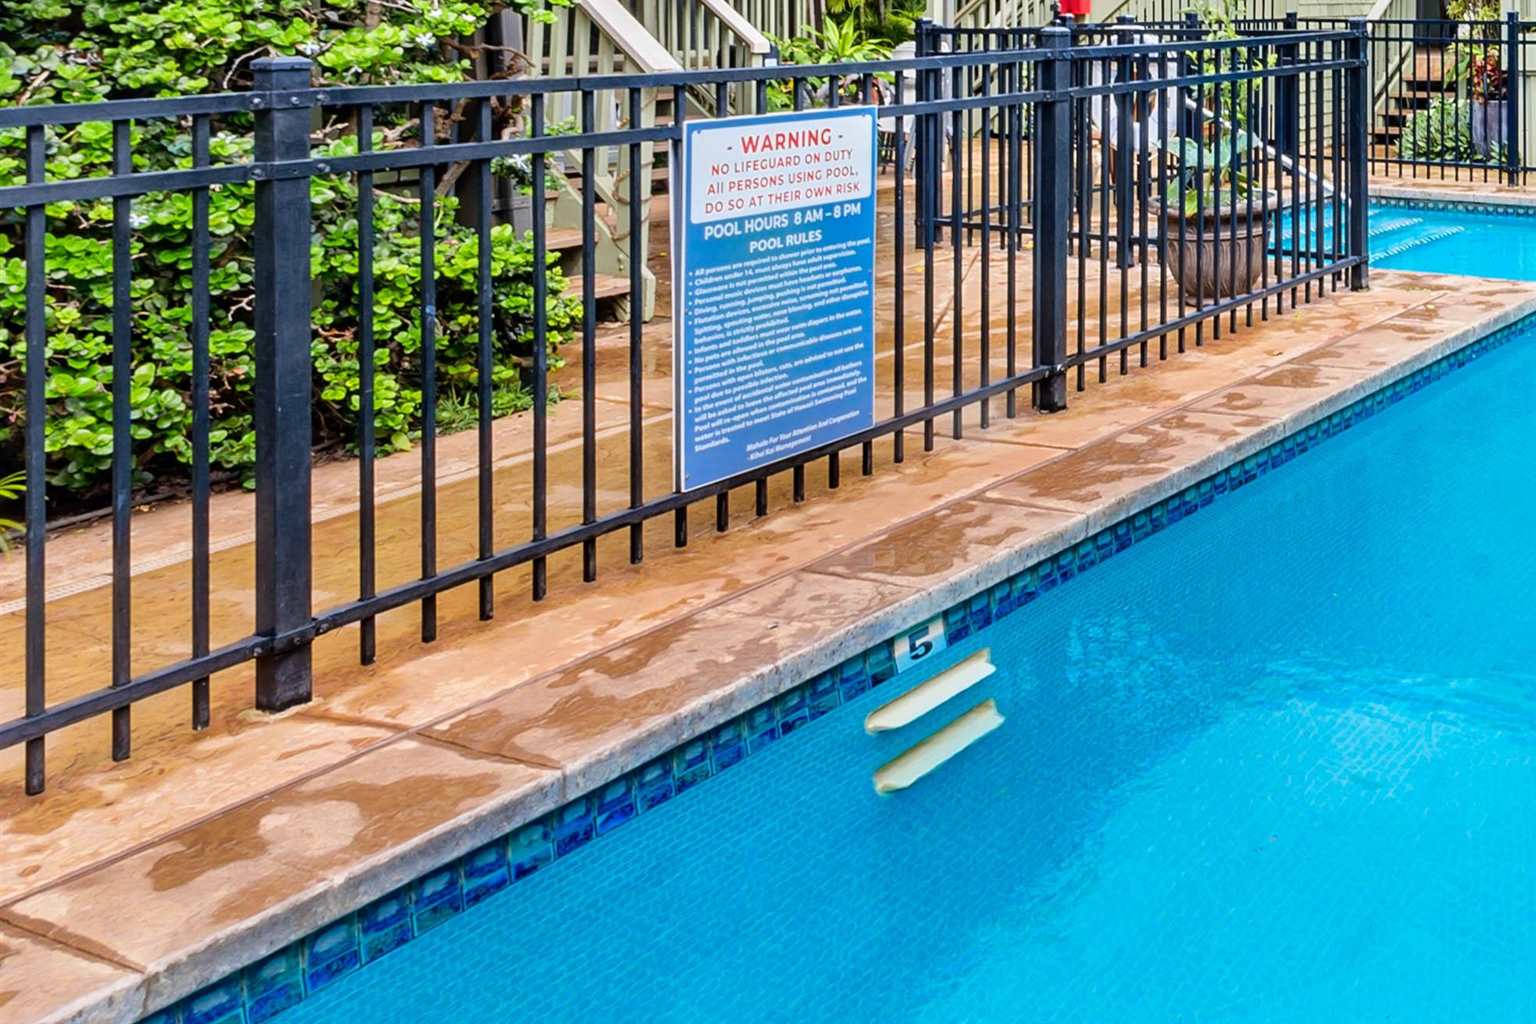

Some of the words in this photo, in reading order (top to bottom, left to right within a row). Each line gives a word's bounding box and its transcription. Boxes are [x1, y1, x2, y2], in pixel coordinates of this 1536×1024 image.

[741, 128, 832, 154] WARNING
[712, 164, 729, 176] NO
[734, 156, 800, 173] LIFEGUARD
[805, 153, 820, 164] ON
[825, 149, 853, 161] DUTY
[707, 183, 724, 195] All
[729, 175, 784, 192] PERSONS
[789, 170, 822, 183] USING
[826, 167, 858, 179] POOL,
[705, 201, 723, 214] DO
[728, 198, 744, 211] SO
[749, 196, 764, 208] AT
[768, 190, 801, 205] THEIR
[805, 187, 832, 198] OWN
[837, 182, 860, 193] RISK
[704, 224, 742, 240] POOL
[744, 216, 789, 233] HOURS
[793, 212, 801, 225] 8
[804, 209, 823, 224] AM
[833, 206, 841, 218] 8
[844, 203, 861, 217] PM
[749, 238, 781, 253] POOL
[786, 230, 822, 246] RULES
[908, 625, 933, 660] 5
